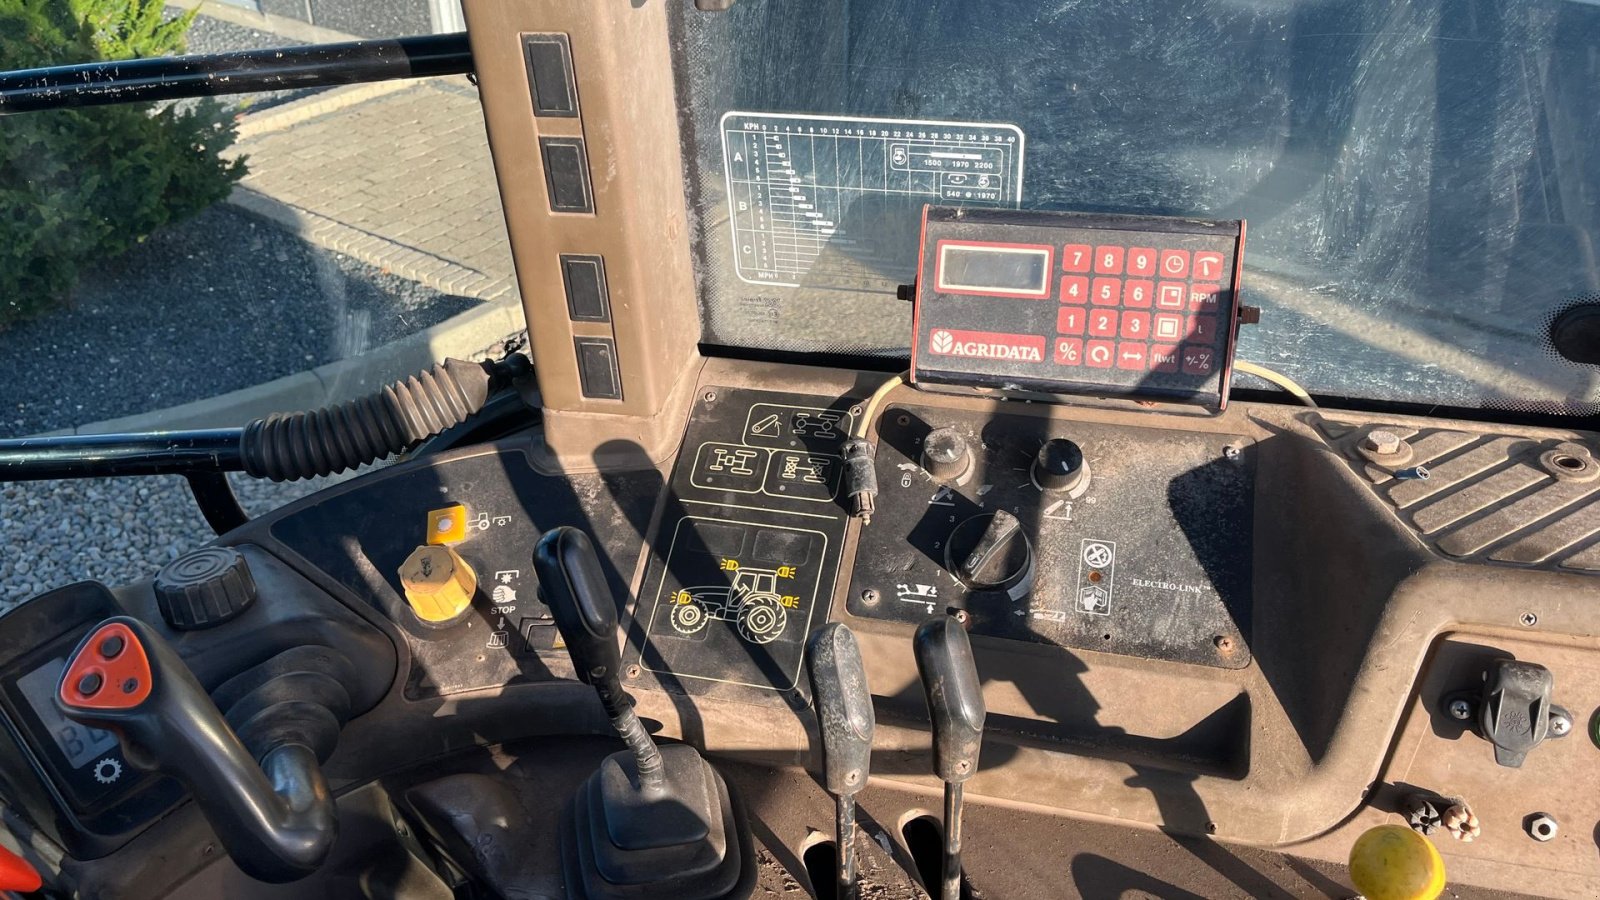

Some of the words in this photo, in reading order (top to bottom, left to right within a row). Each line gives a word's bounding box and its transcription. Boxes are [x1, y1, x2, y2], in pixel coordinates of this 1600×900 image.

[744, 123, 759, 131] KPH
[733, 152, 743, 162] A
[738, 201, 748, 211] B
[743, 245, 752, 254] C
[1073, 252, 1083, 266] 7
[1104, 253, 1114, 268] 8
[1136, 255, 1147, 270] 9
[1069, 283, 1079, 297] 4
[1101, 285, 1111, 299] 5
[1133, 287, 1143, 301] 6
[1191, 292, 1217, 304] RPM
[1068, 315, 1075, 328] 1
[1098, 317, 1108, 330] 2
[1130, 319, 1140, 332] 3
[952, 341, 1041, 361] AGRIDATA
[949, 515, 955, 523] 3
[934, 541, 940, 549] 2
[1132, 578, 1202, 594] ELECTRO-LINK
[491, 606, 516, 615] STOP
